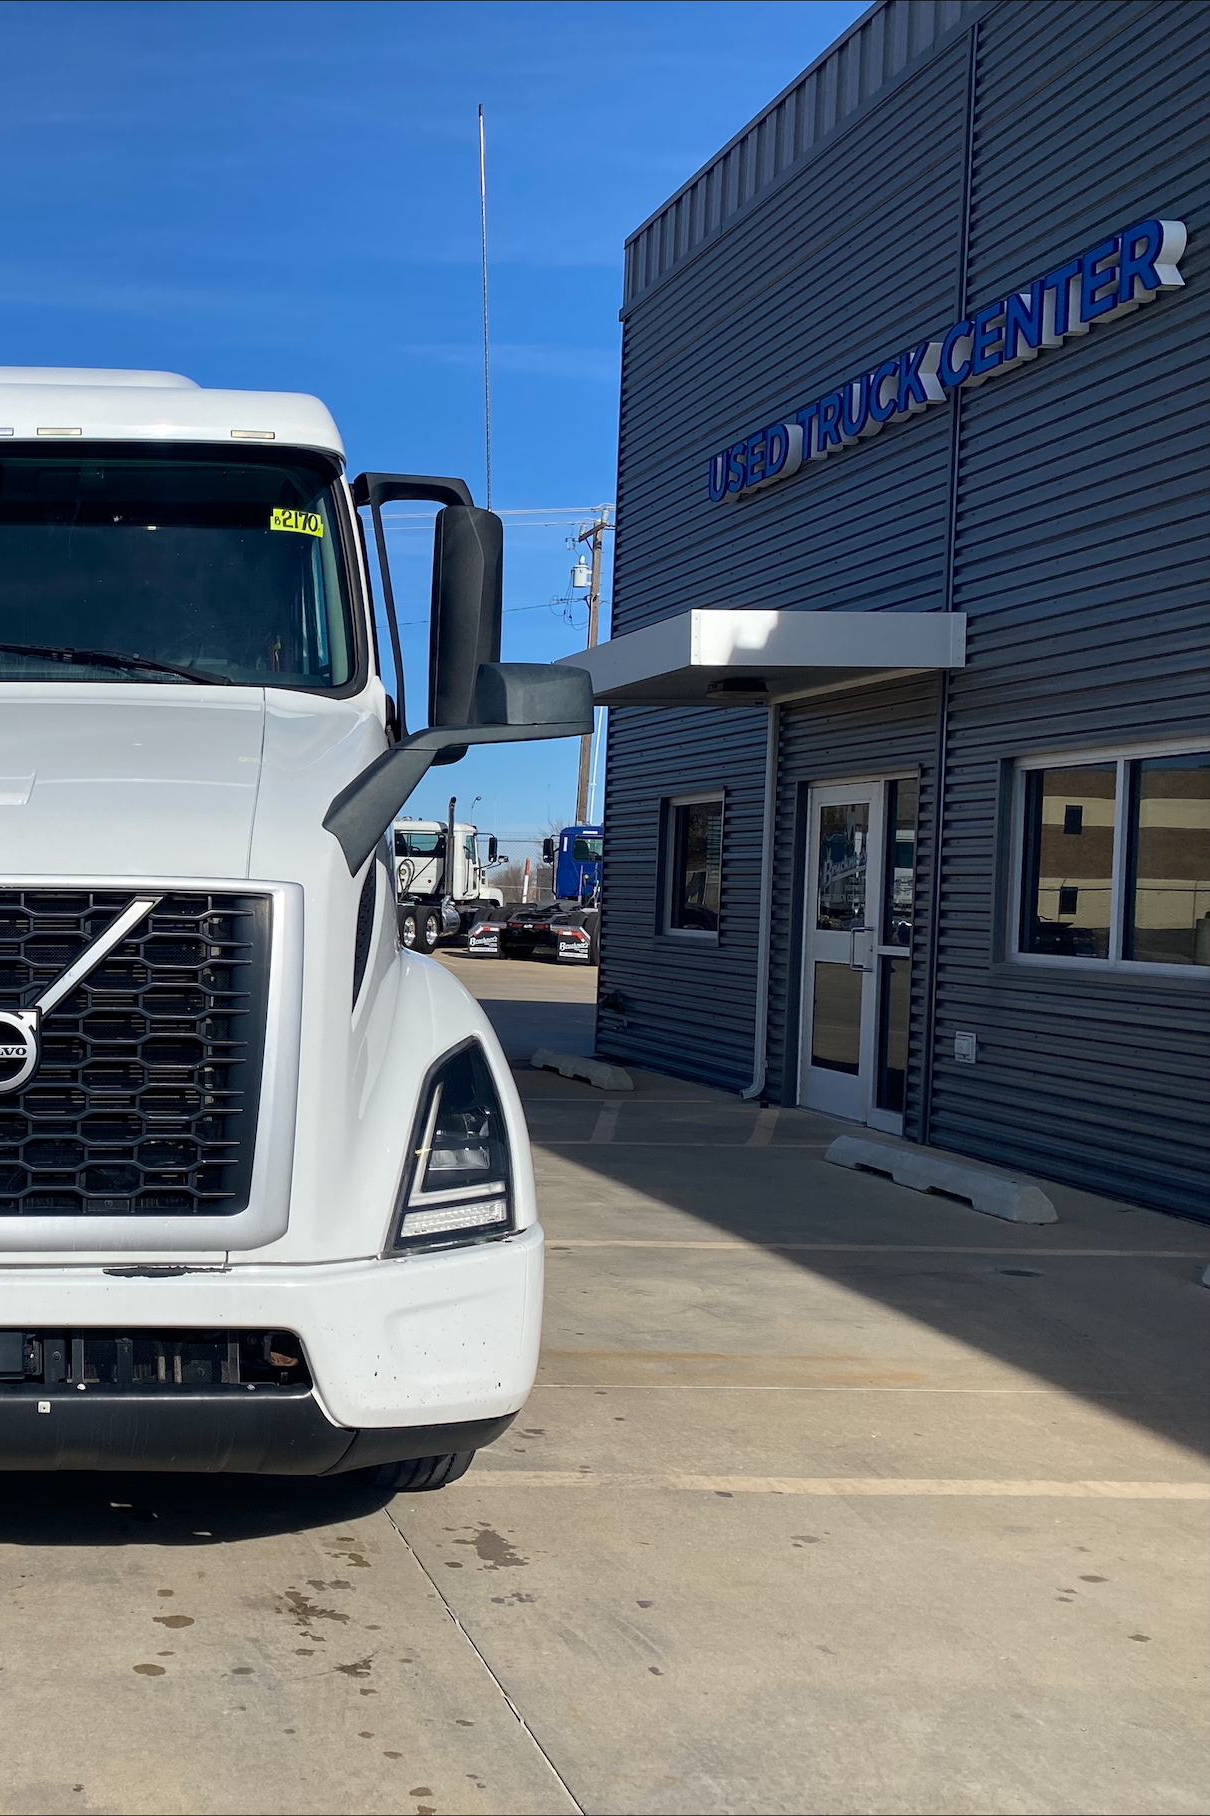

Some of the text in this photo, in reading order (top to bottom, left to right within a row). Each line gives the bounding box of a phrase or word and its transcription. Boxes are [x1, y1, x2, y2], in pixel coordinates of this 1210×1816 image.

[708, 219, 1177, 501] USED TRUCK CENTER
[282, 509, 319, 532] 2170
